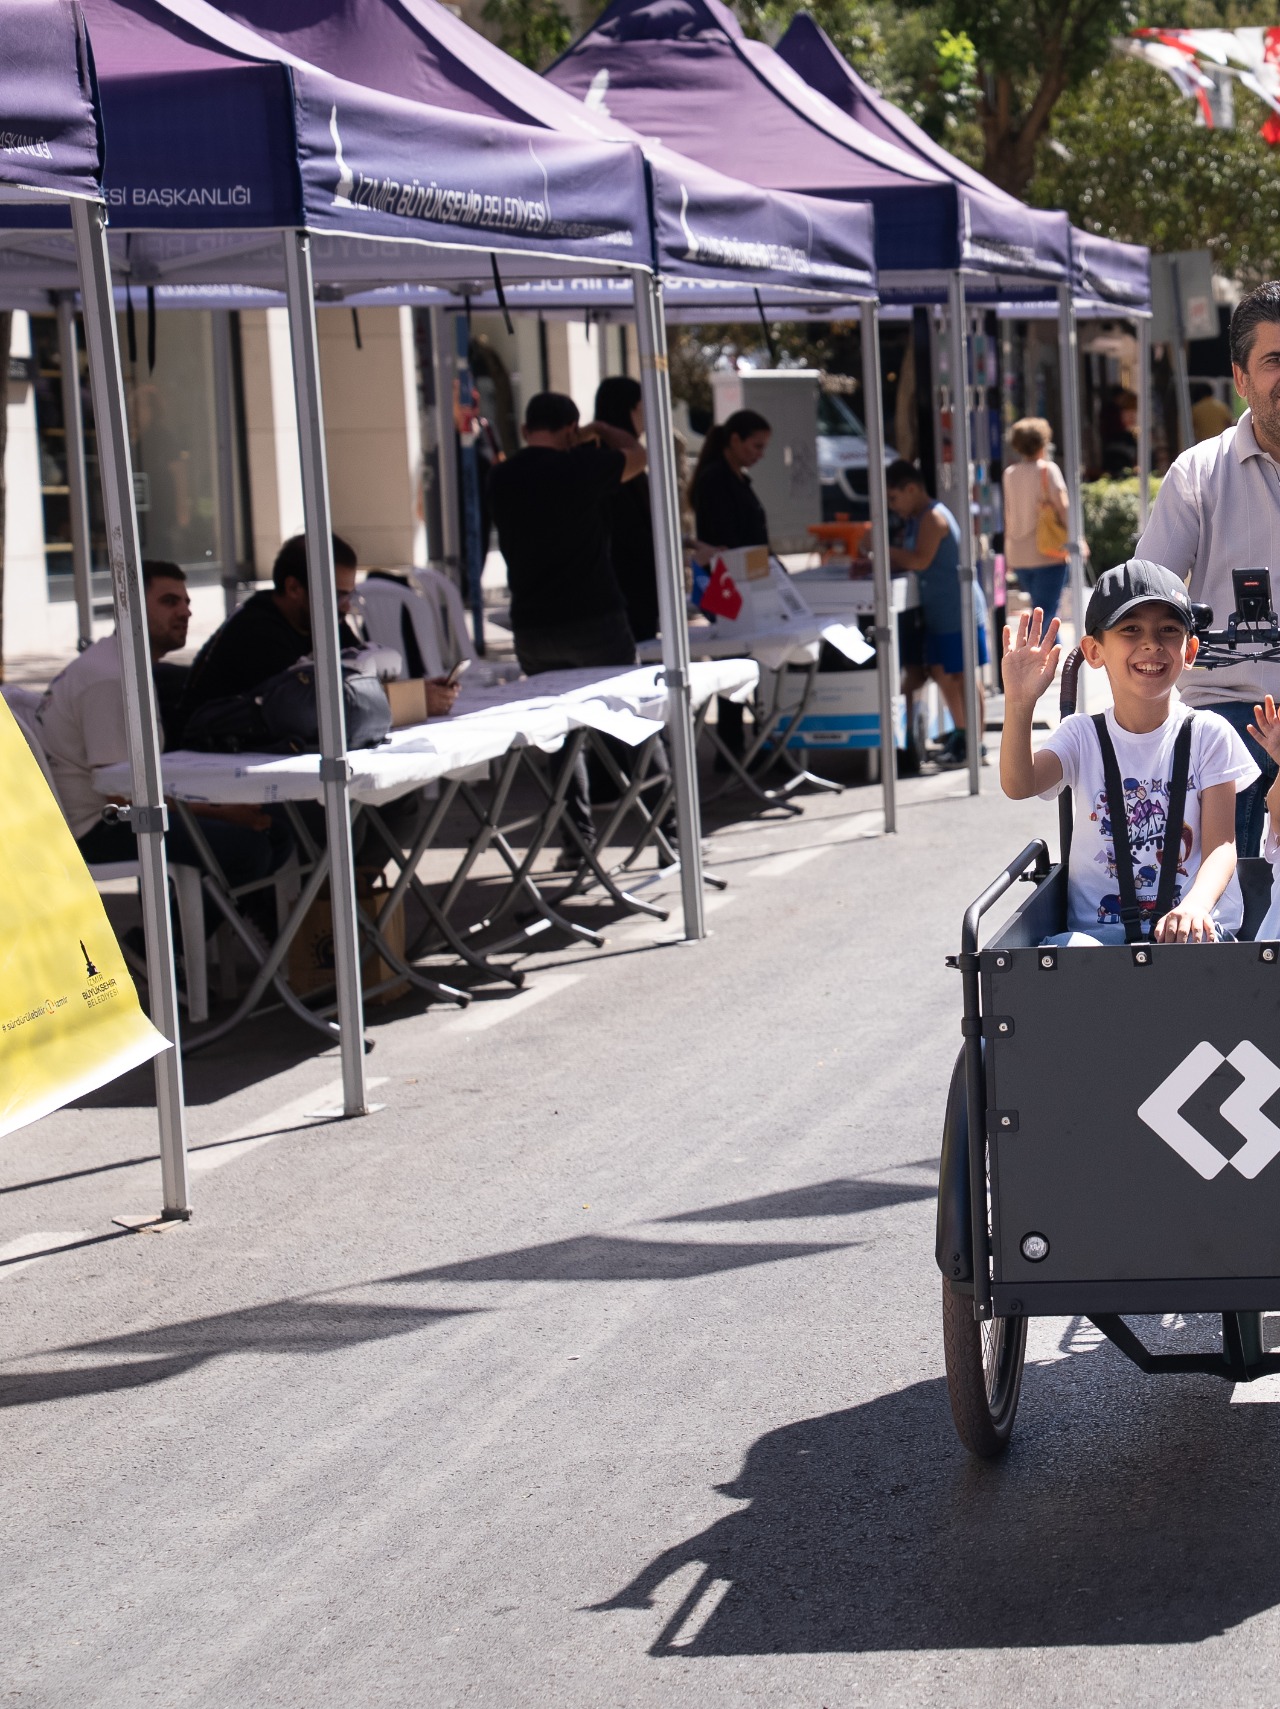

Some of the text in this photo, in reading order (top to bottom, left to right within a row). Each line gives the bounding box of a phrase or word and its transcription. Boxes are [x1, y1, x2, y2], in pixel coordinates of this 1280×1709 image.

[132, 185, 251, 208] BAŞKANLIĞI
[354, 172, 547, 232] İZMİR BÜYÜKŞEHİR BELEDİYESİ
